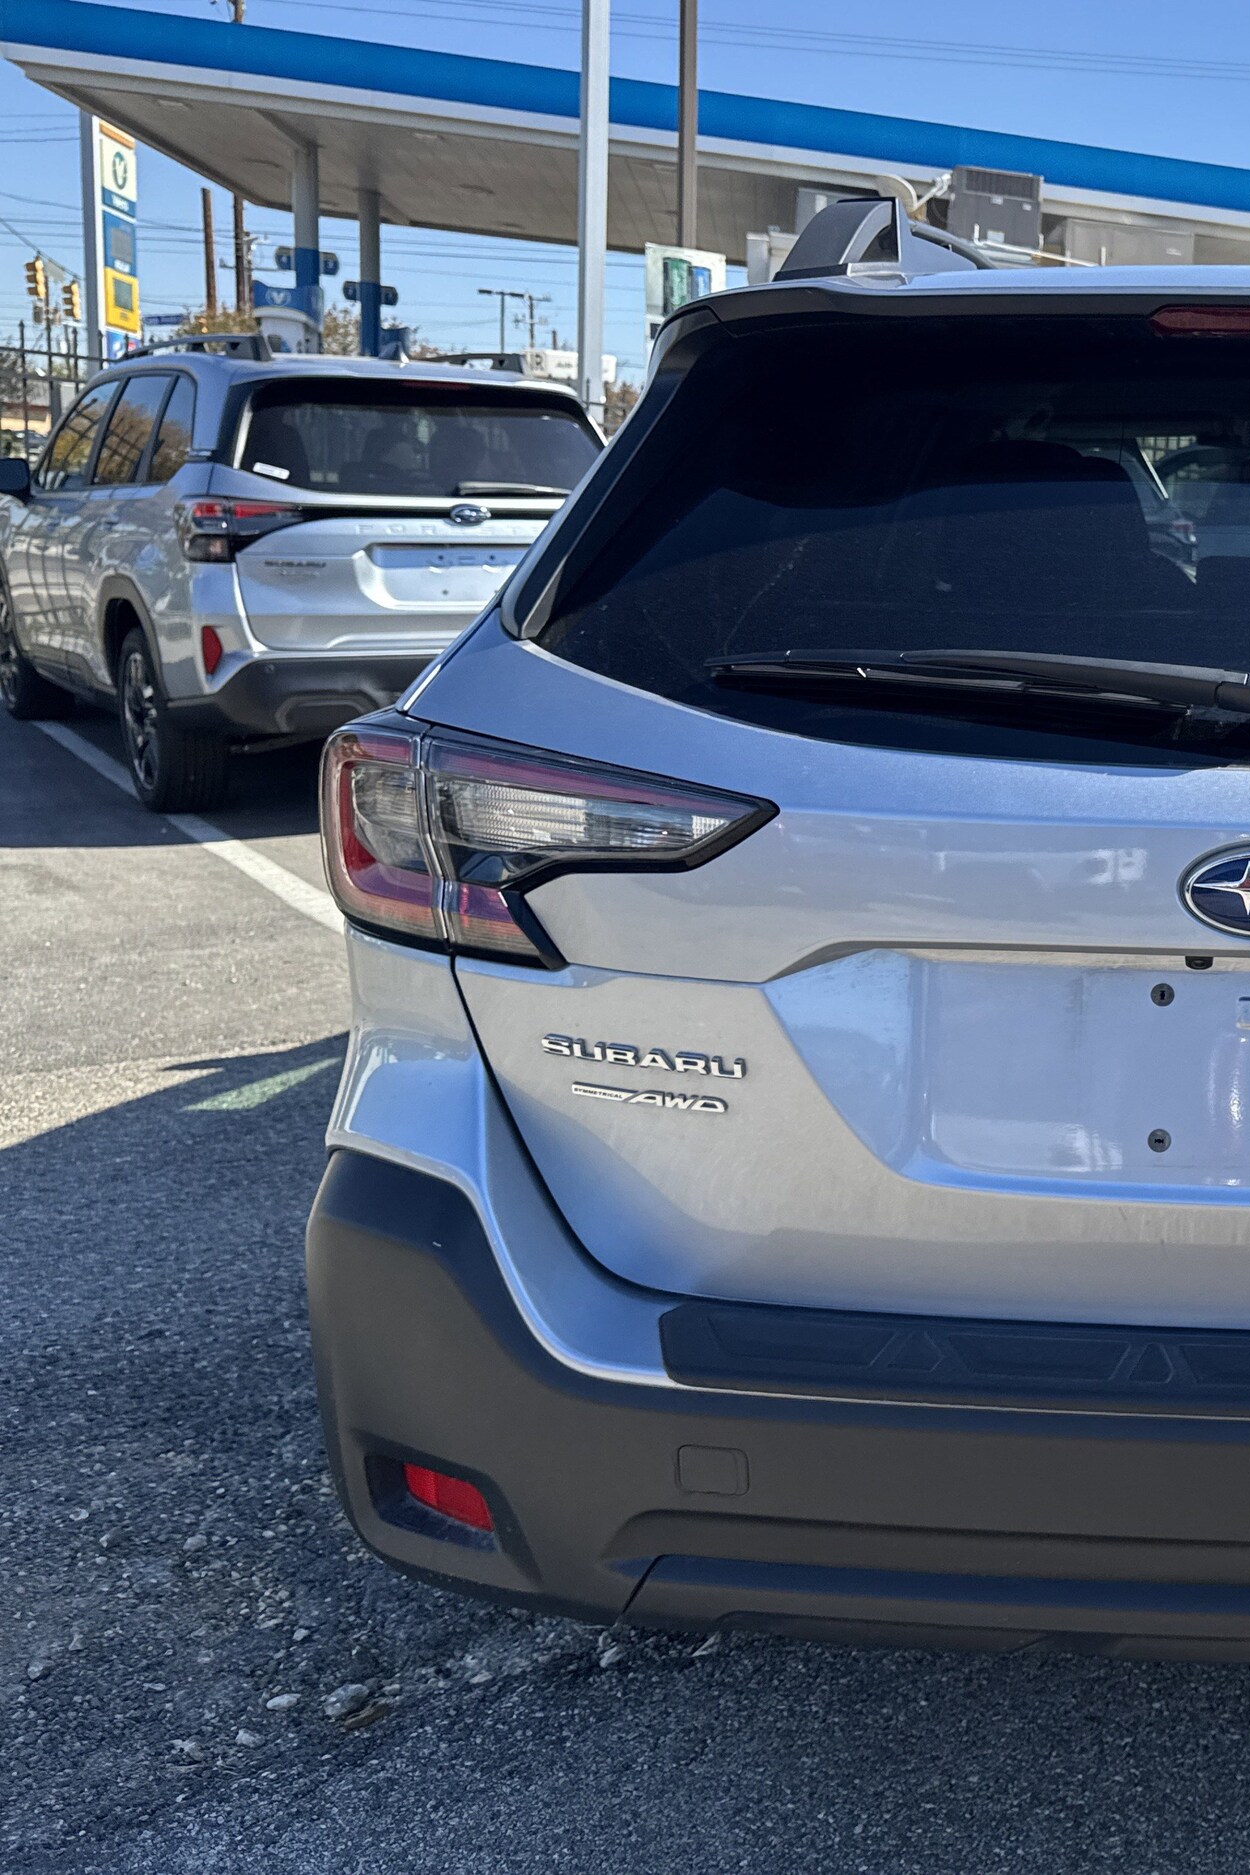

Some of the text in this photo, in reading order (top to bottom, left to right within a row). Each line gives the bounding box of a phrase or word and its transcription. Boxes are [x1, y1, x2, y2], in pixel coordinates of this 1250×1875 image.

[354, 523, 541, 536] FOREST
[541, 1033, 747, 1079] SUBARU
[573, 1086, 728, 1113] SYMMETRICAL AWD
